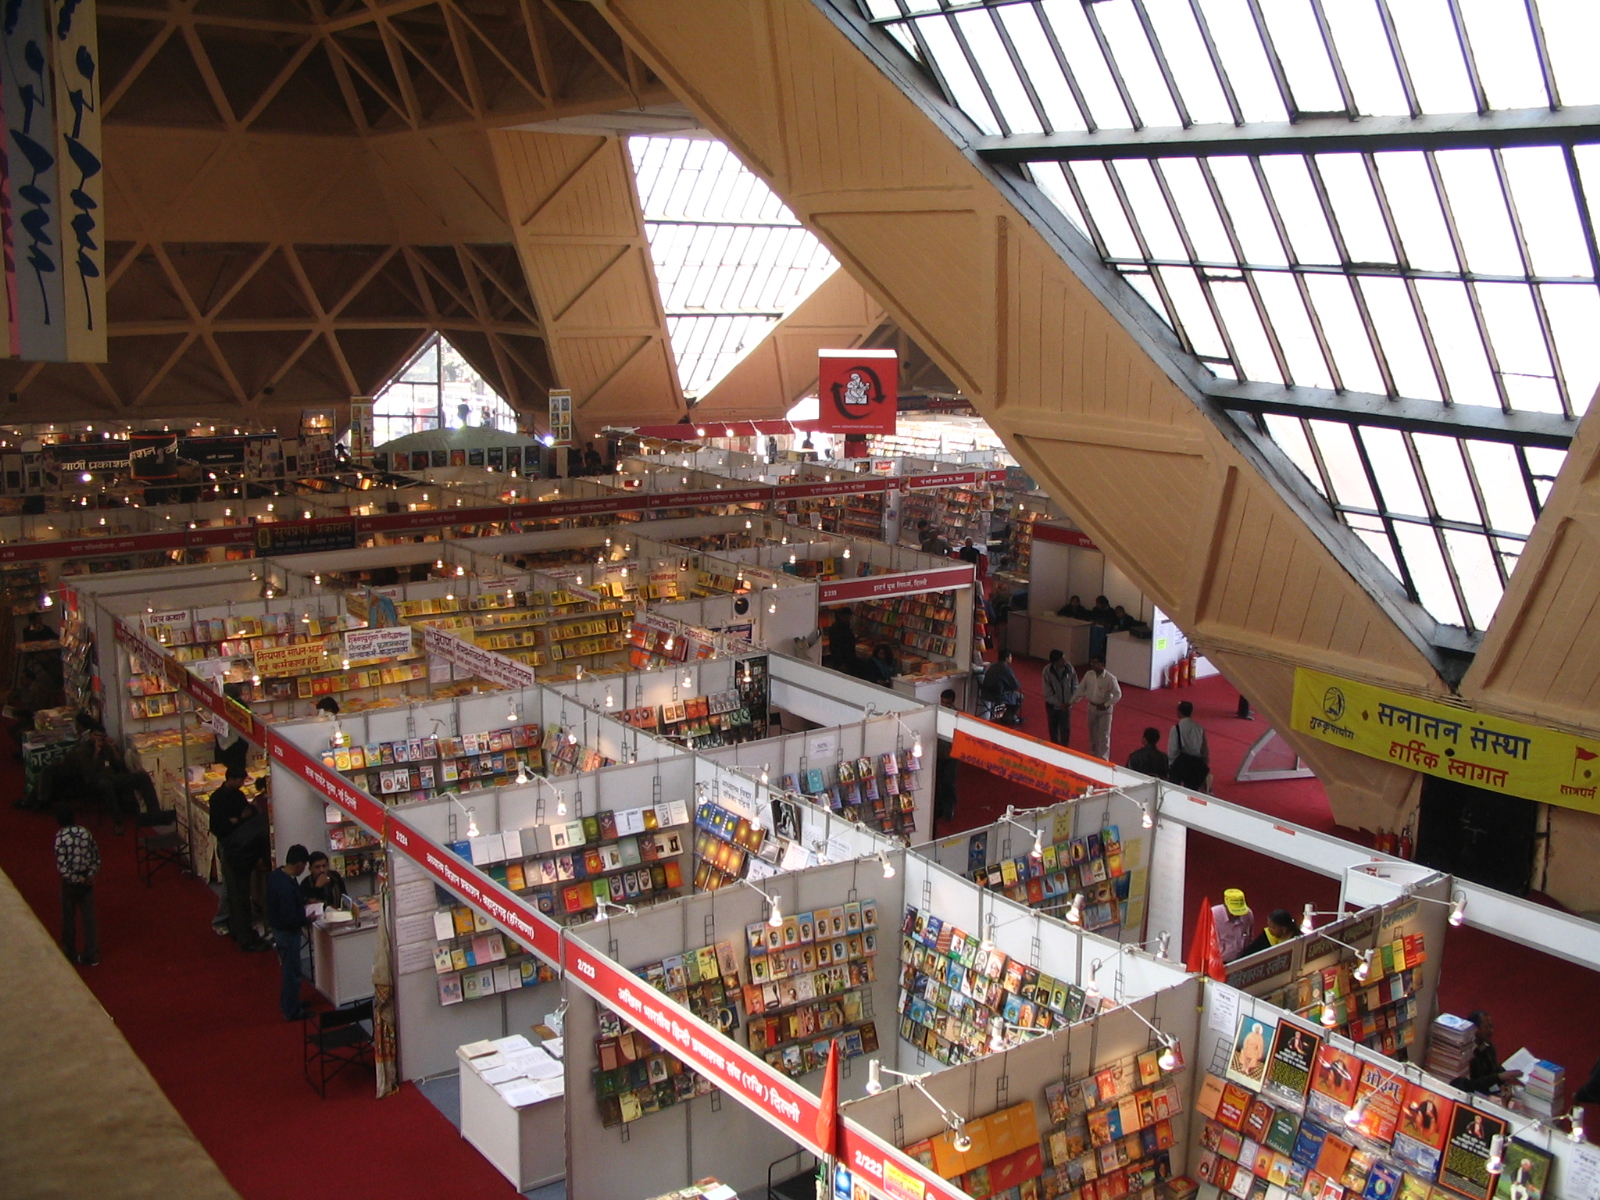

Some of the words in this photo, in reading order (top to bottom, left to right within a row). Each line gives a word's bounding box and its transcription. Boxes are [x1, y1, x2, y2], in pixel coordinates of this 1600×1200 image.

[1377, 703, 1463, 744] सनातन
[1470, 720, 1532, 760] संस्था
[1388, 740, 1440, 769] हार्दिक
[1447, 757, 1509, 788] स्वागत
[577, 958, 596, 979] 2/223
[618, 987, 642, 1014] अखिल
[643, 1001, 671, 1033] भारतीय
[671, 1021, 691, 1048] हिन्दी
[692, 1037, 725, 1071] प्रकाशक
[725, 1057, 742, 1082] संघ
[769, 1089, 801, 1123] दिल्ली
[854, 1150, 882, 1178] 2/222
